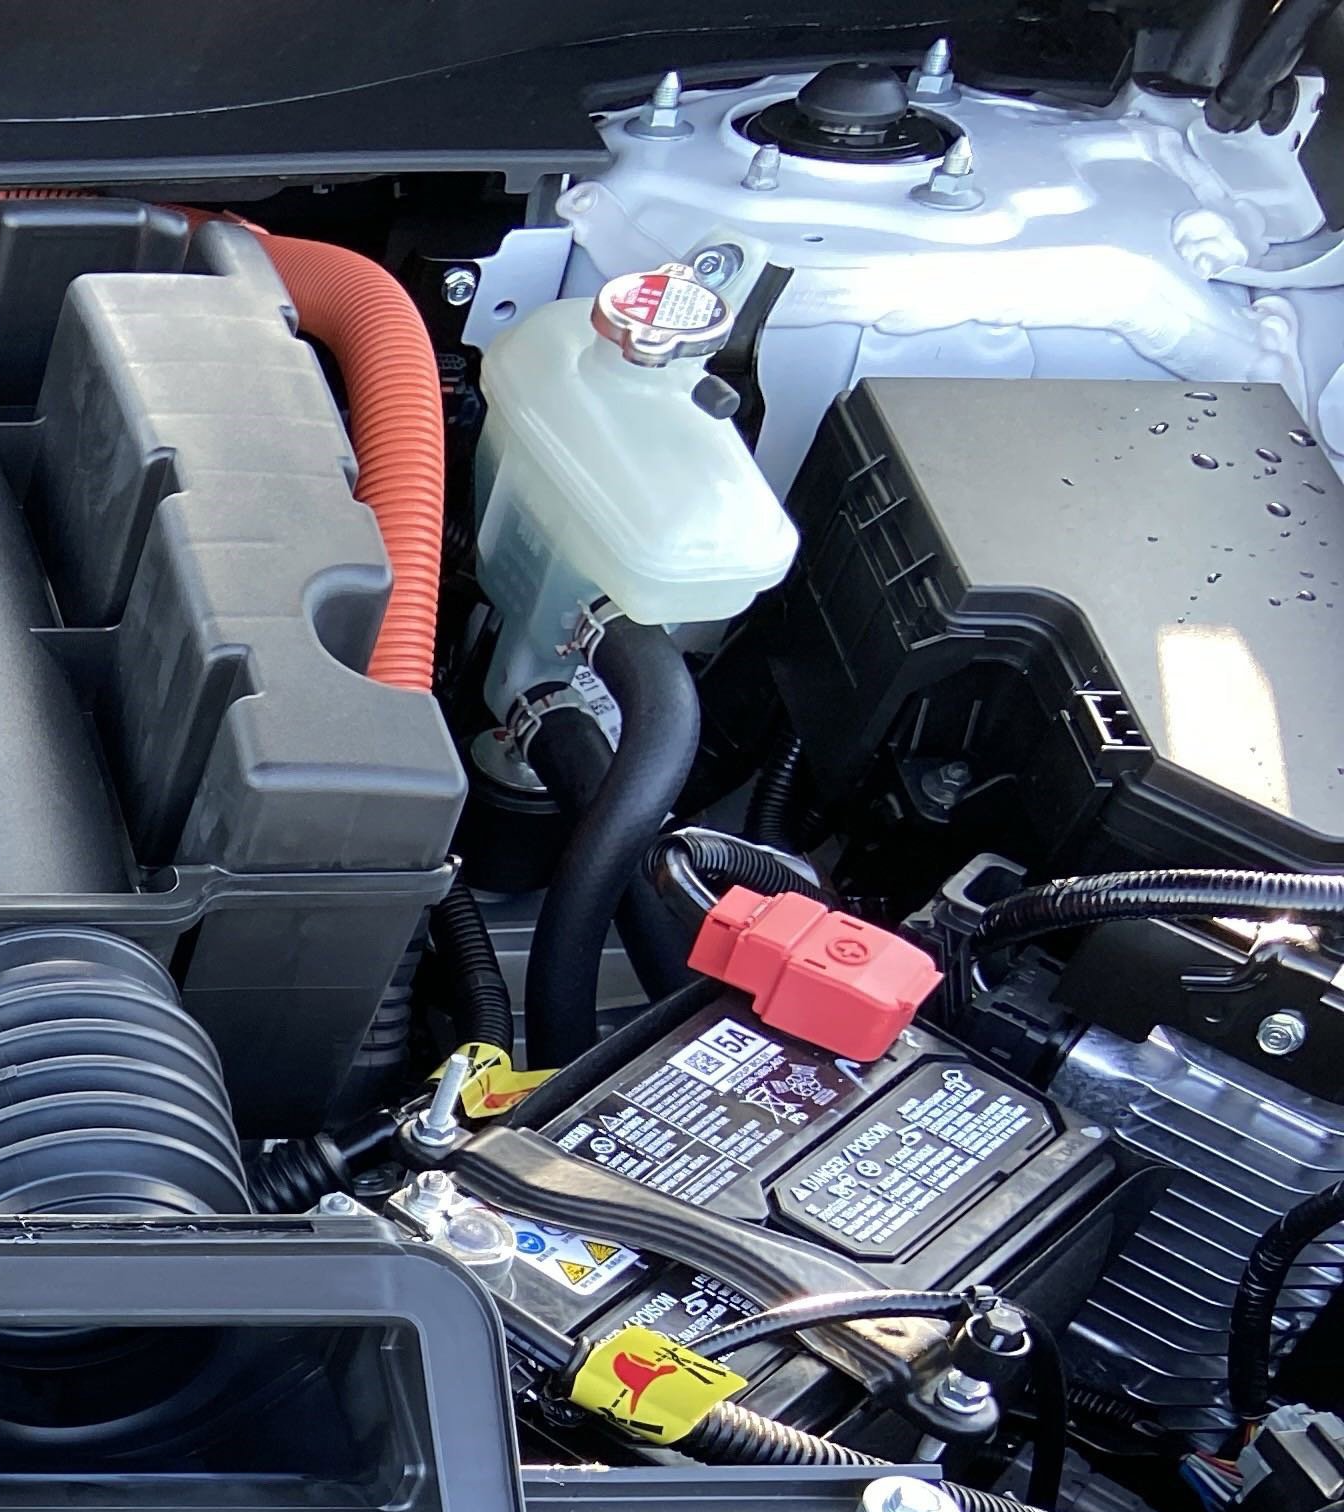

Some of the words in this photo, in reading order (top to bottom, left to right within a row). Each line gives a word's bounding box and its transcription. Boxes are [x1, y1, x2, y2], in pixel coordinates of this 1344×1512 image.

[712, 1028, 757, 1053] 5A
[801, 1155, 850, 1193] DANGER
[848, 1122, 894, 1158] POISON
[632, 1292, 679, 1328] POISON
